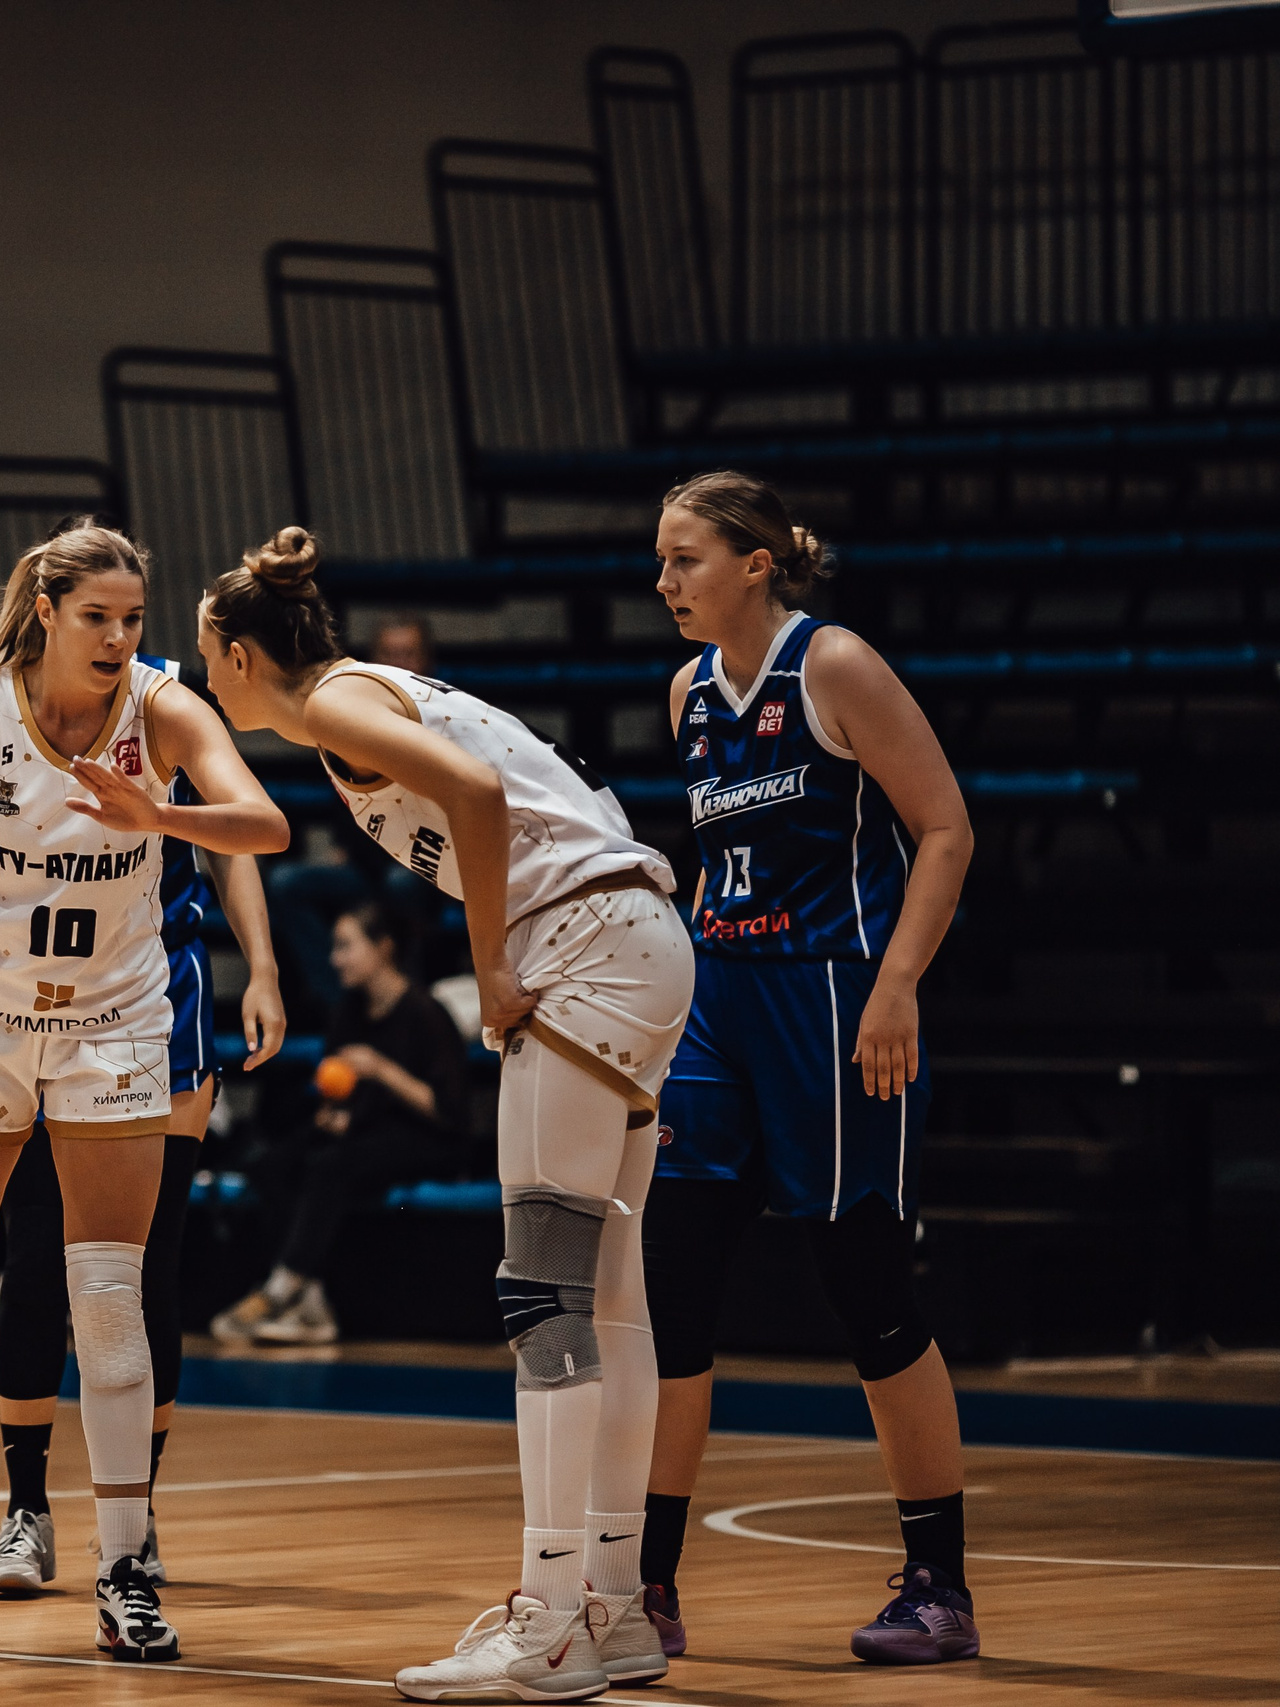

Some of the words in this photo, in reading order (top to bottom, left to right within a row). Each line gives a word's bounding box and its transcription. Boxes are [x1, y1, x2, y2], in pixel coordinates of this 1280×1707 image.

[689, 713, 709, 724] PEAK
[760, 704, 785, 719] FON
[757, 717, 782, 732] BET
[692, 774, 795, 824] КАЗАНОЧКА
[721, 846, 751, 897] 13
[29, 905, 97, 958] 10
[92, 1091, 152, 1105] ХИМПРОМ
